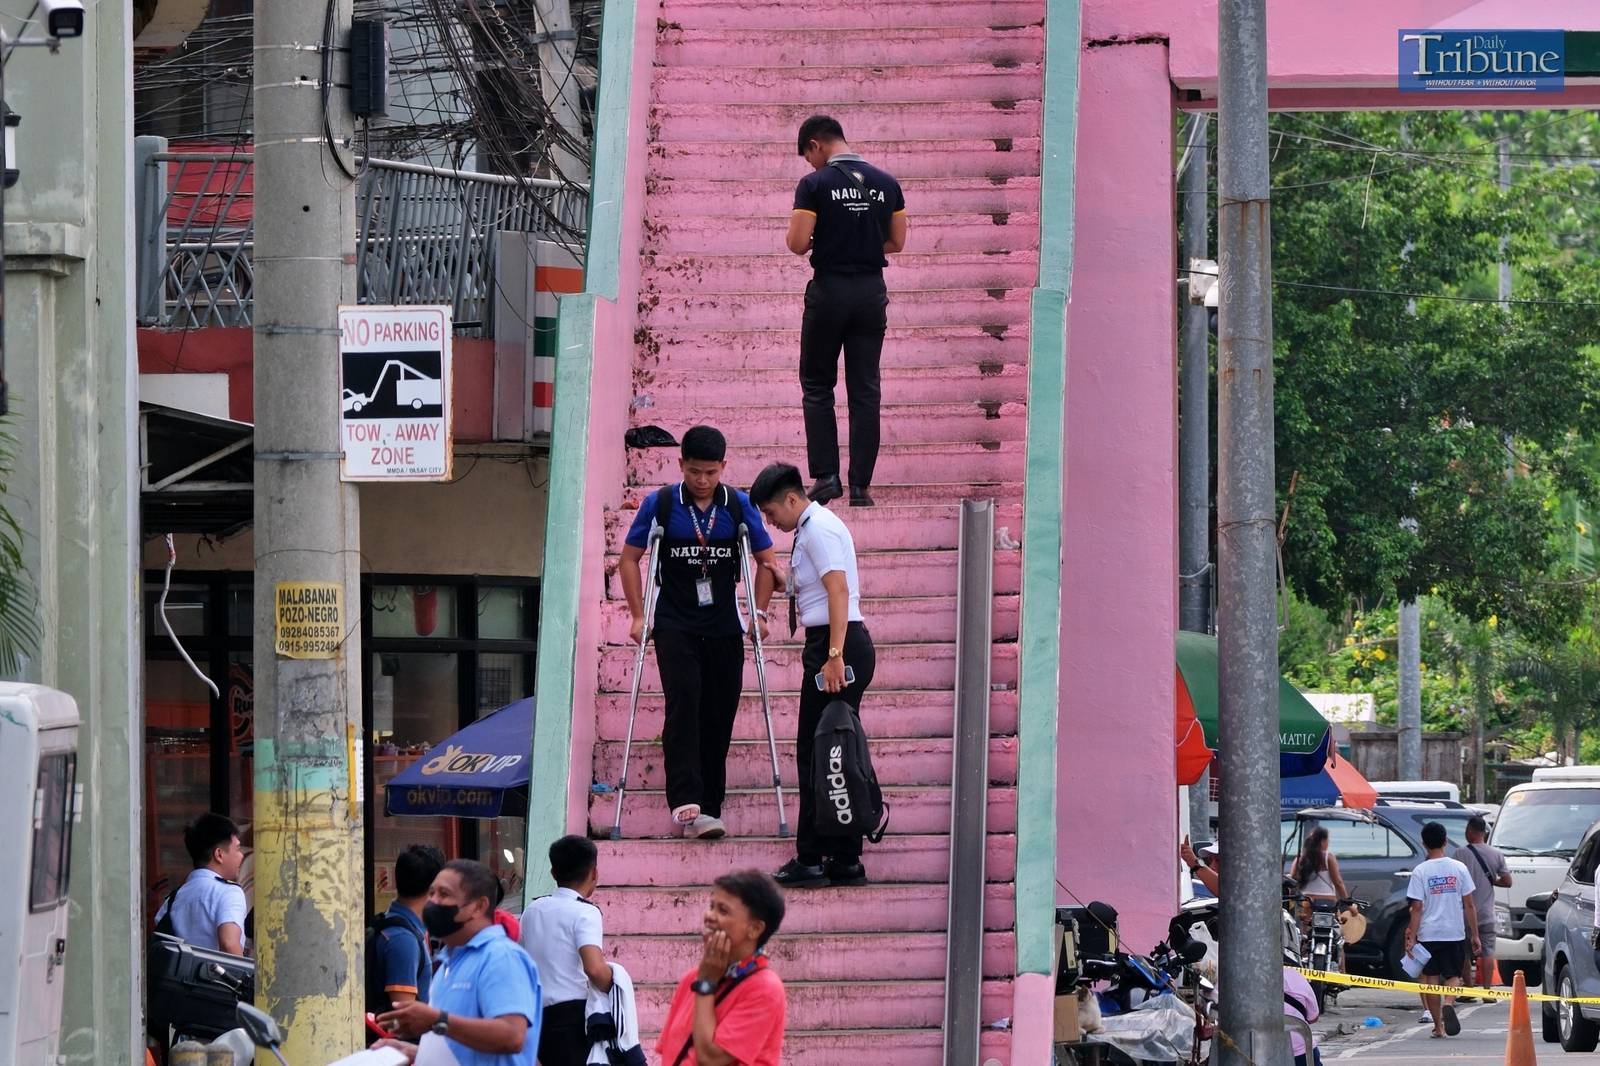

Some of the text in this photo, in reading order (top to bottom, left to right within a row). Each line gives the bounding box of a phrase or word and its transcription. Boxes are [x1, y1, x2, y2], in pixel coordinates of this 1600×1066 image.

[343, 319, 440, 346] NO PARKING
[346, 424, 381, 442] TOW
[395, 423, 440, 441] AWAY
[371, 447, 415, 465] ZONE
[670, 546, 732, 558] NAUICA
[279, 588, 337, 605] MALABANAN
[280, 607, 338, 623] POZO-NEGRO
[280, 626, 340, 638] 09284085367
[827, 745, 853, 825] adidas
[1349, 976, 1395, 988] CAUTION
[1418, 984, 1464, 994] CAUTION
